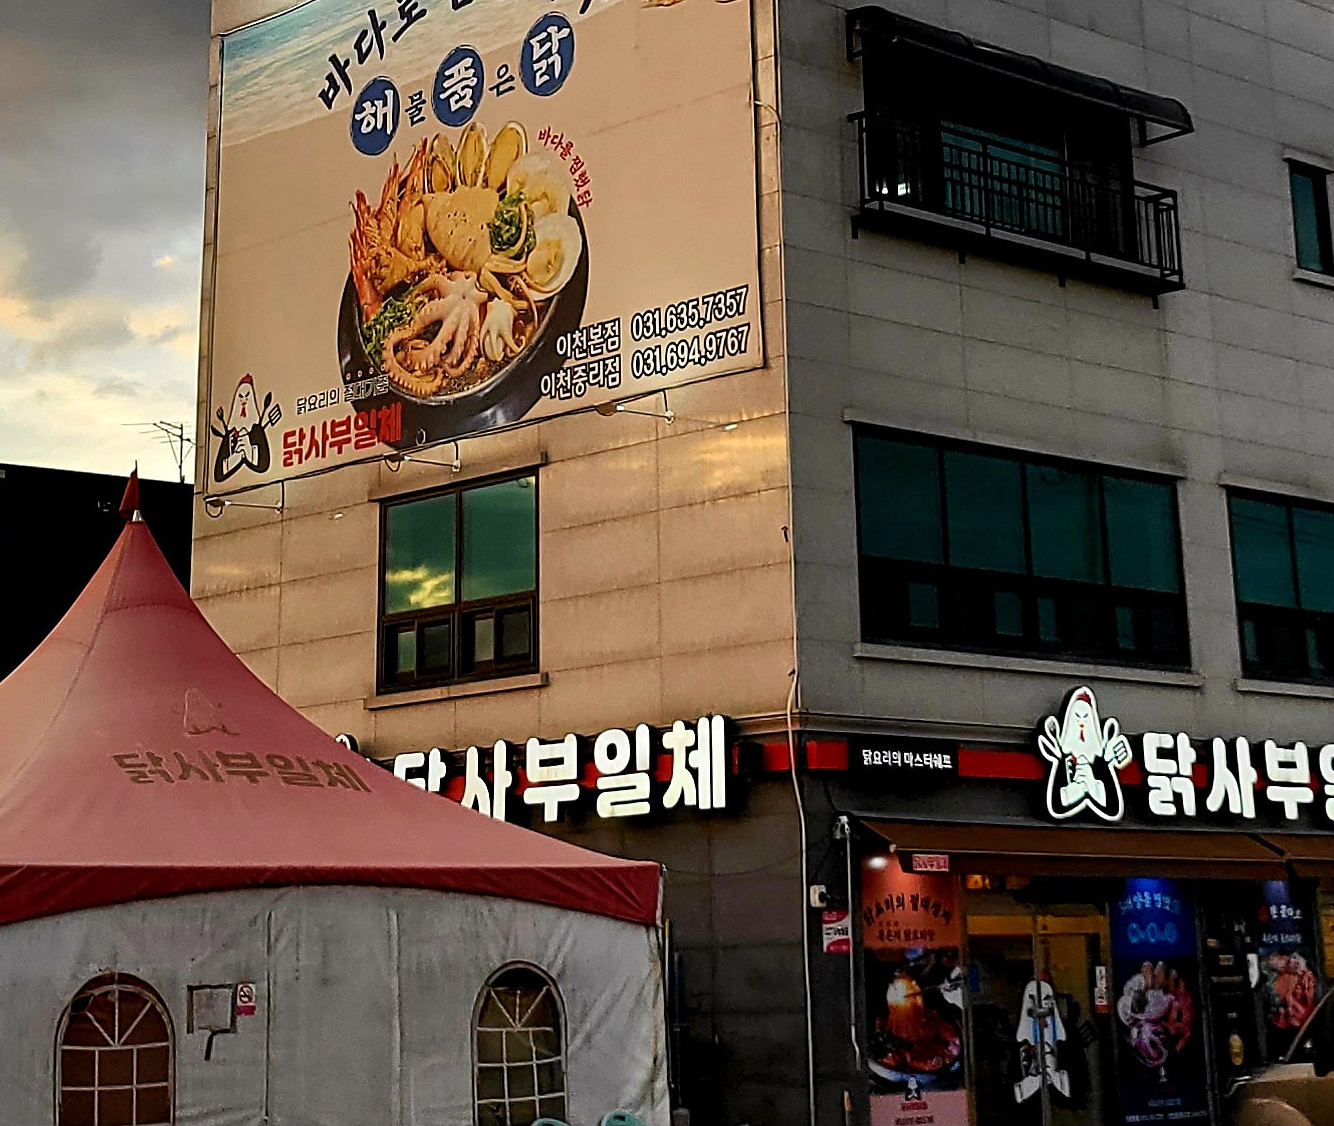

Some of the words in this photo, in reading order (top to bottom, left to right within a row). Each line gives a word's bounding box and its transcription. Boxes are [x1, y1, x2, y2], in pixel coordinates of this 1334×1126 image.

[537, 125, 575, 161] 바다를
[568, 155, 594, 208] 찜했닭
[556, 318, 621, 359] 이천본점
[631, 284, 749, 341] 031.635.7357
[540, 354, 621, 400] 이천중리점
[631, 322, 751, 379] 031.694.9767
[282, 401, 403, 468] 닭사부일체
[296, 387, 340, 416] 닭요리의
[112, 750, 373, 793] 닭사부일체
[862, 749, 902, 768] 닭요리의
[903, 751, 953, 770] 마스터쉐프
